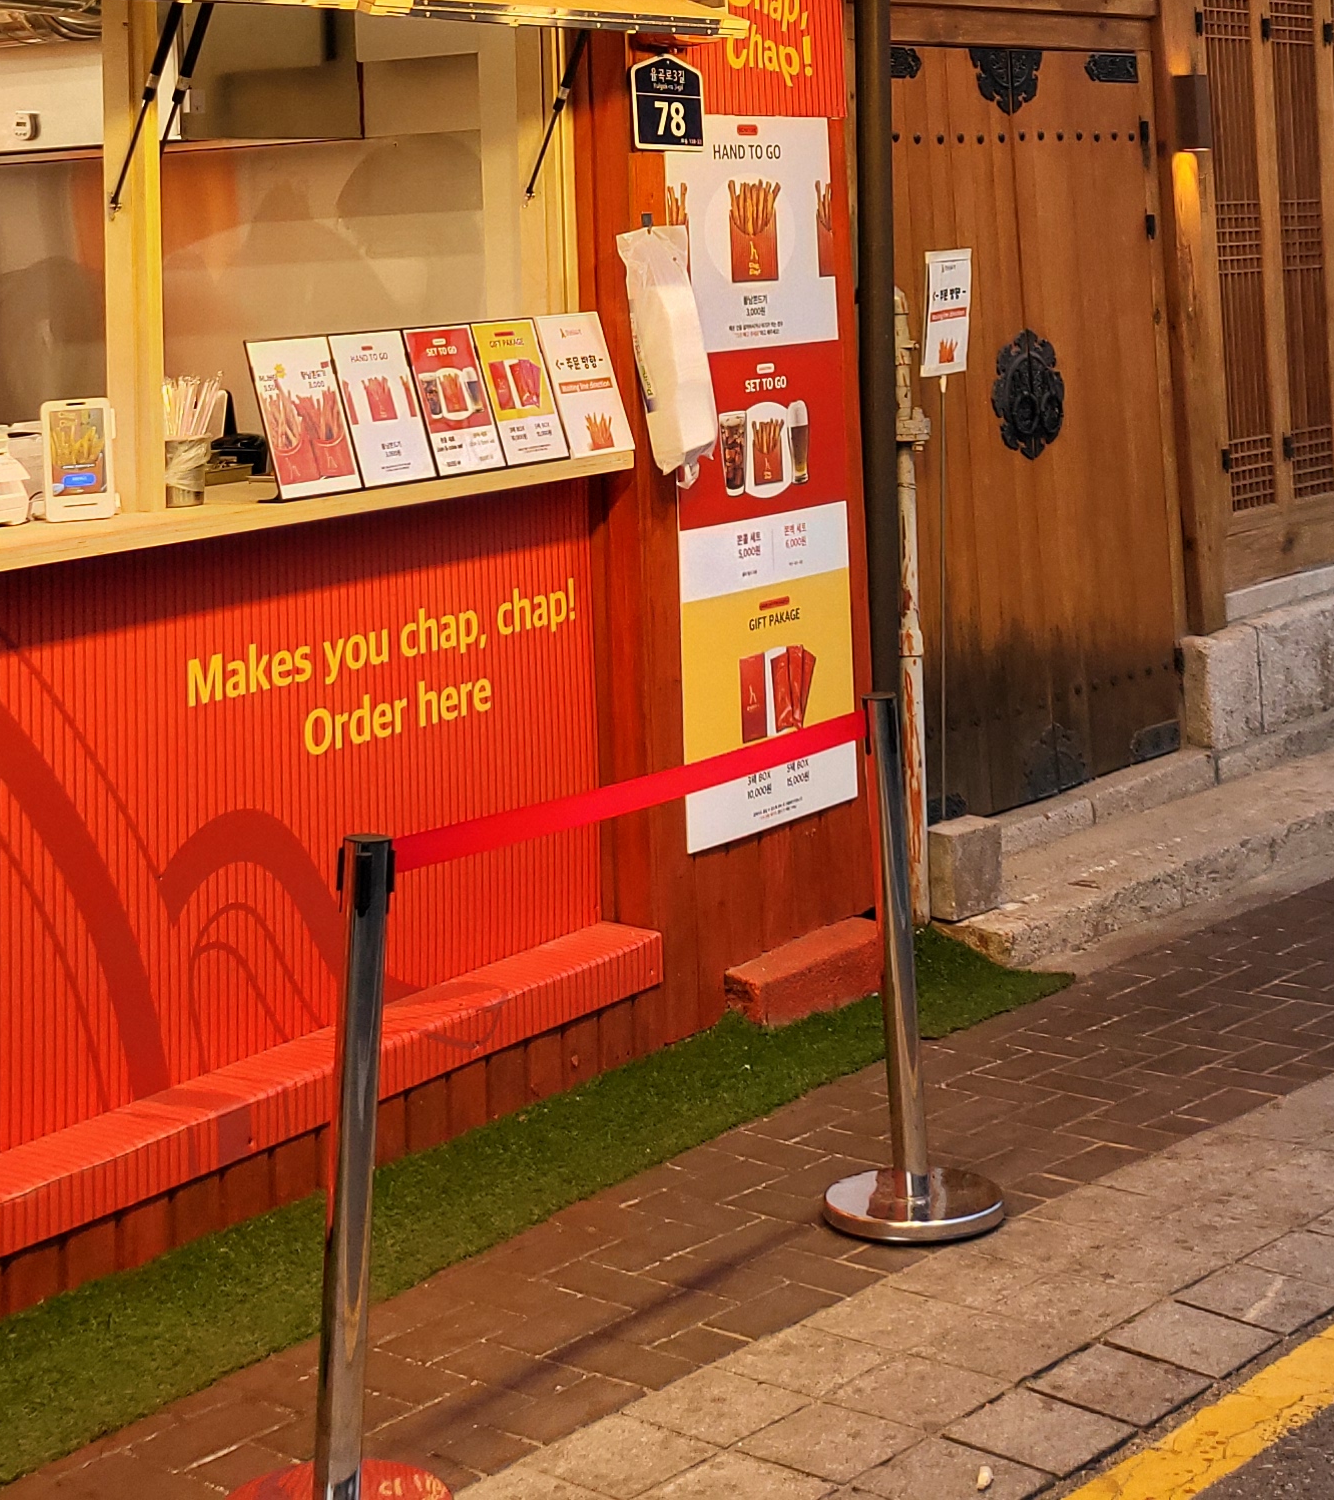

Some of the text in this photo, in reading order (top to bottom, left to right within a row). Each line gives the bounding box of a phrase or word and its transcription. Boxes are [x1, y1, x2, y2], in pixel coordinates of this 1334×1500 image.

[726, 24, 813, 87] Chap!
[654, 101, 686, 137] 78
[713, 144, 781, 160] HAND TO GO
[745, 376, 787, 393] SET TO GO
[749, 607, 800, 631] GIFT PAKAGE
[186, 577, 576, 707] Makes you chap, chap!
[304, 677, 492, 756] Order here
